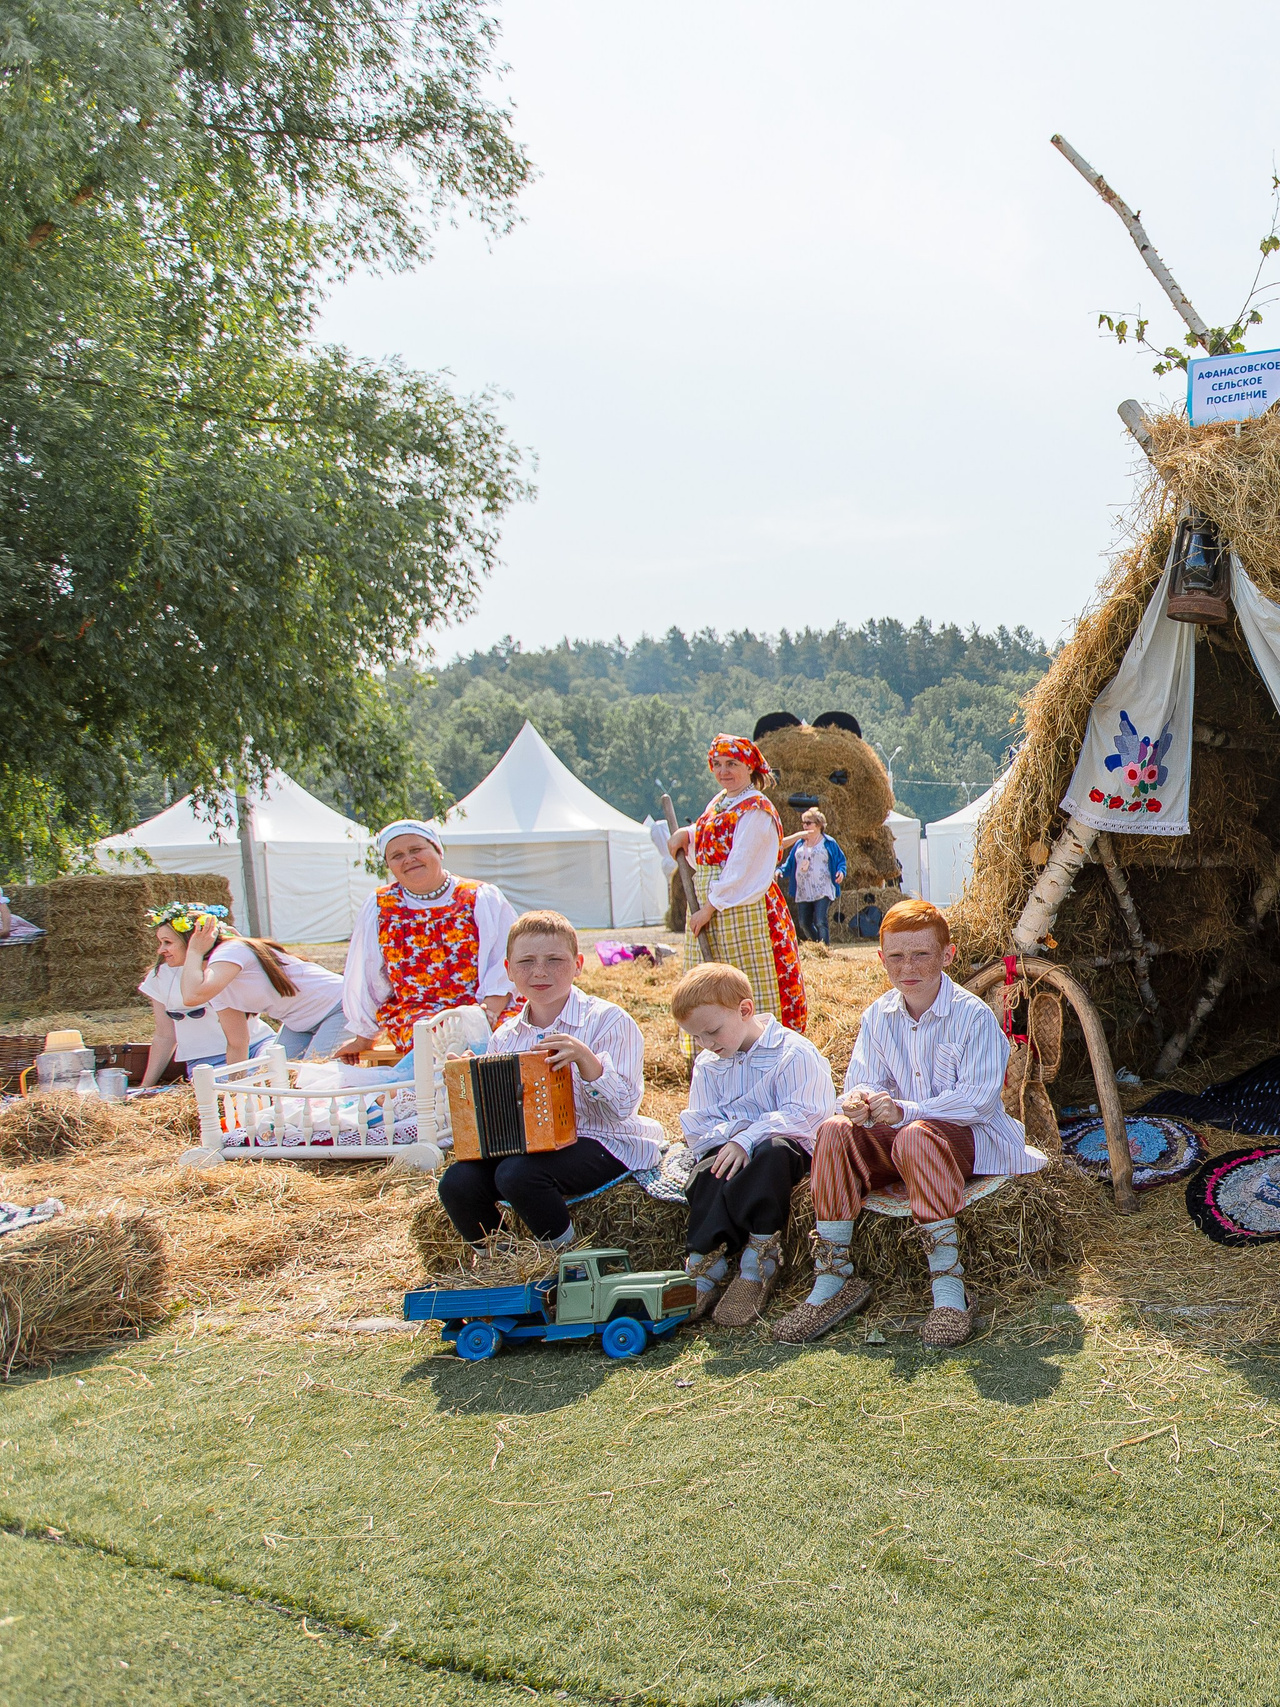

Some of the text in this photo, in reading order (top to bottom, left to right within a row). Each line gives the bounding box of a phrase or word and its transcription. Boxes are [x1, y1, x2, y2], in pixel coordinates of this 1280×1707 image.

[1197, 361, 1280, 380] АФАНАСОВСКОЕ
[1211, 376, 1263, 392] СЕЛЬСКОЕ
[1206, 390, 1268, 405] ПОСЕЛЕНИЕ
